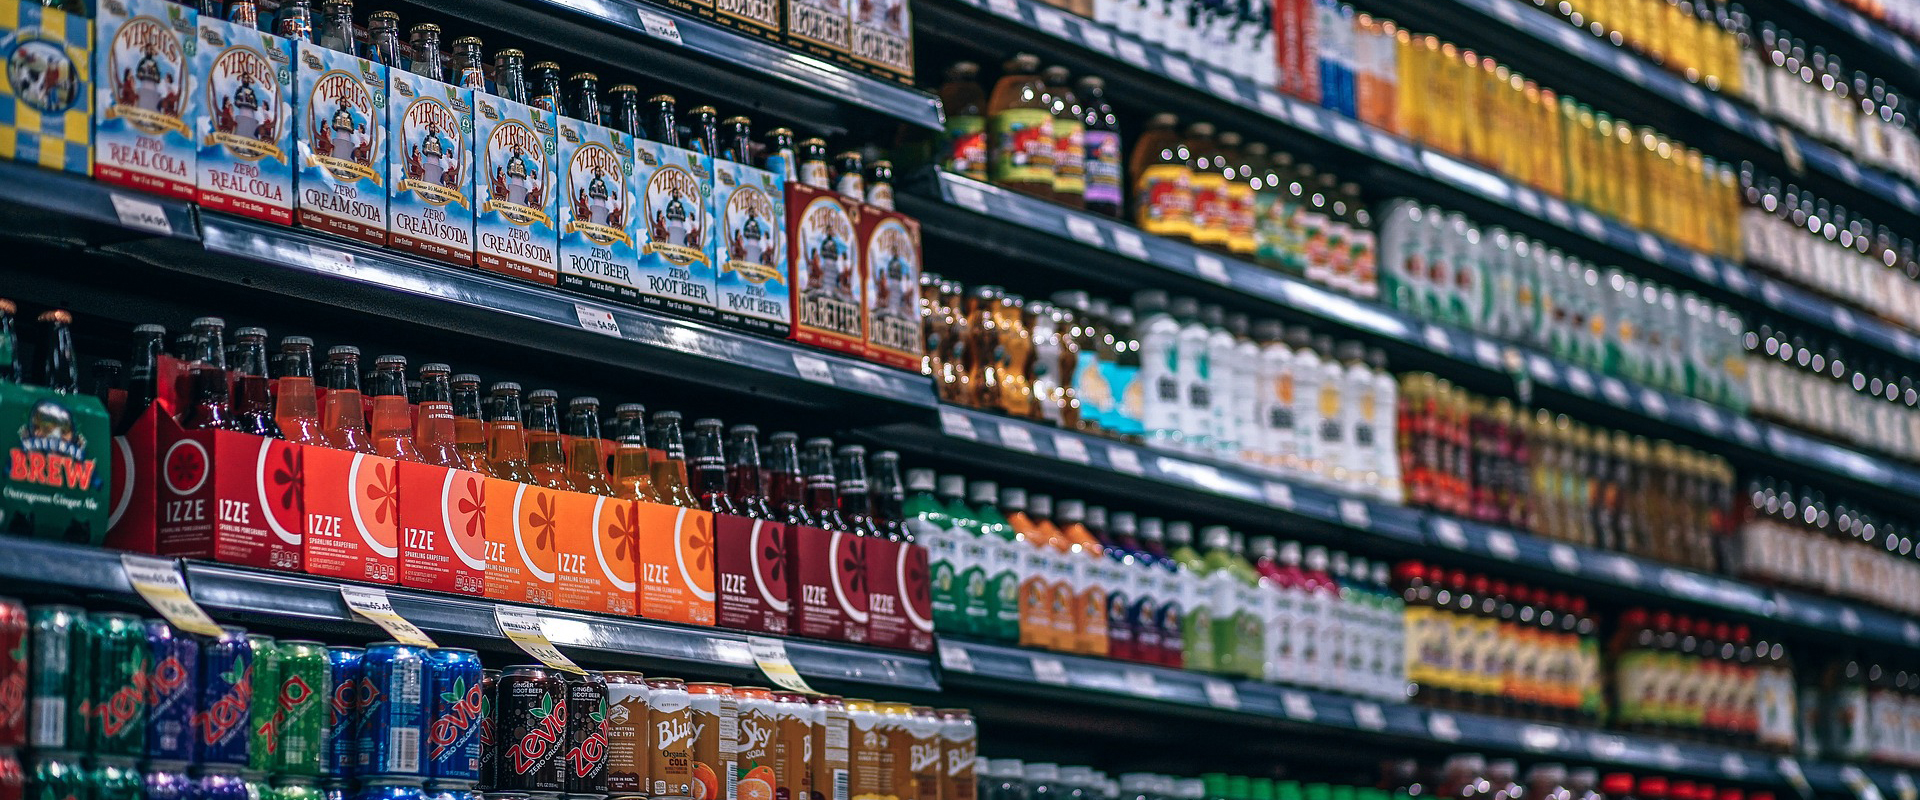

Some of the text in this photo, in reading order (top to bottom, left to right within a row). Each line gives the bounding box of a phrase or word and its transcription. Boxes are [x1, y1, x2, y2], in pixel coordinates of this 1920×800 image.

[122, 22, 176, 62] VIRGIL'S
[220, 52, 271, 90] VIRGIL'S
[320, 75, 367, 113] VIRGIL'S
[410, 102, 456, 139] VIRGIL'S
[136, 136, 163, 152] ZERO
[495, 125, 539, 161] VIRGIL'S
[108, 143, 186, 176] REAL COLA
[234, 162, 258, 178] ZERO
[577, 147, 618, 181] VIRGIL'S
[208, 170, 246, 191] REAL
[249, 179, 282, 201] COLA
[334, 183, 356, 199] ZERO
[654, 170, 697, 203] VIRGIL'S
[306, 188, 381, 222] CREAM SODA
[424, 207, 446, 222] ZERO
[396, 213, 468, 245] CREAM SODA
[508, 227, 530, 242] ZERO
[482, 233, 552, 264] CREAM SODA
[591, 247, 612, 260] ZERO
[570, 255, 632, 284] ROOT BEER
[668, 267, 690, 280] ZERO
[647, 275, 710, 304] ROOT BEER
[746, 285, 764, 298] ZERO
[726, 292, 754, 310] ROOT
[755, 299, 785, 320] BEER
[598, 320, 618, 332] $4.99
[9, 448, 95, 490] BREW
[52, 492, 82, 509] Ginger
[84, 497, 98, 510] Ale
[167, 499, 205, 522] IZZE
[220, 499, 250, 524] IZZE
[308, 514, 342, 538] IZZE
[309, 538, 358, 550] SPARKLING GRAPEFRUIT
[404, 528, 434, 550] IZZE
[404, 550, 450, 562] SPARKLING GRAPEFRUIT
[484, 541, 506, 563] ZZE
[558, 552, 586, 574] IZZE
[644, 562, 669, 584] IZZE
[722, 573, 746, 594] IZZE
[803, 584, 828, 606] IZZE
[505, 699, 567, 774] zevia
[738, 718, 772, 752] Sky
[438, 746, 456, 763] ZERO
[565, 719, 608, 778] zev
[662, 750, 688, 759] Organic
[746, 750, 766, 760] SODA
[528, 760, 546, 776] ZERO
[588, 762, 602, 778] ZERO
